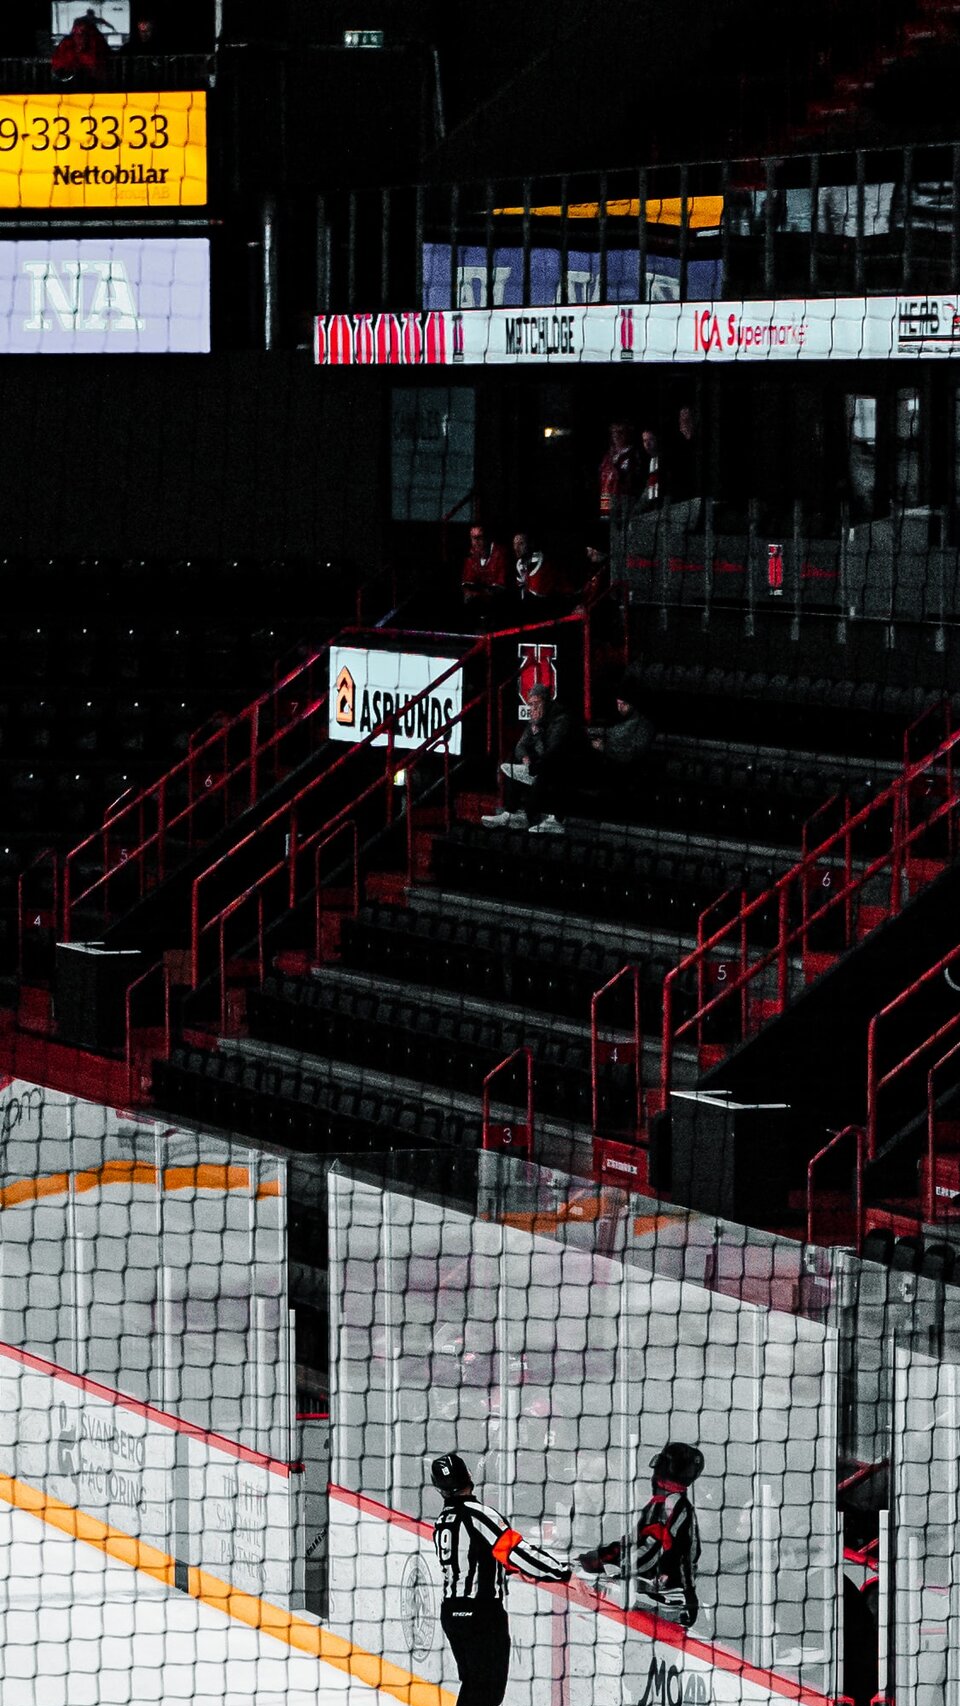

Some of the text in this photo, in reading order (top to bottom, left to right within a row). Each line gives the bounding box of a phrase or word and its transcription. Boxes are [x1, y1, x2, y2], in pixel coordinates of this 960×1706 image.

[53, 164, 169, 185] Nettobilar
[24, 260, 145, 332] NA
[694, 310, 723, 352] ICA
[359, 689, 454, 742] ASPLUNDS
[822, 872, 832, 888] 6
[716, 963, 728, 981] 5
[502, 1128, 512, 1144] 3
